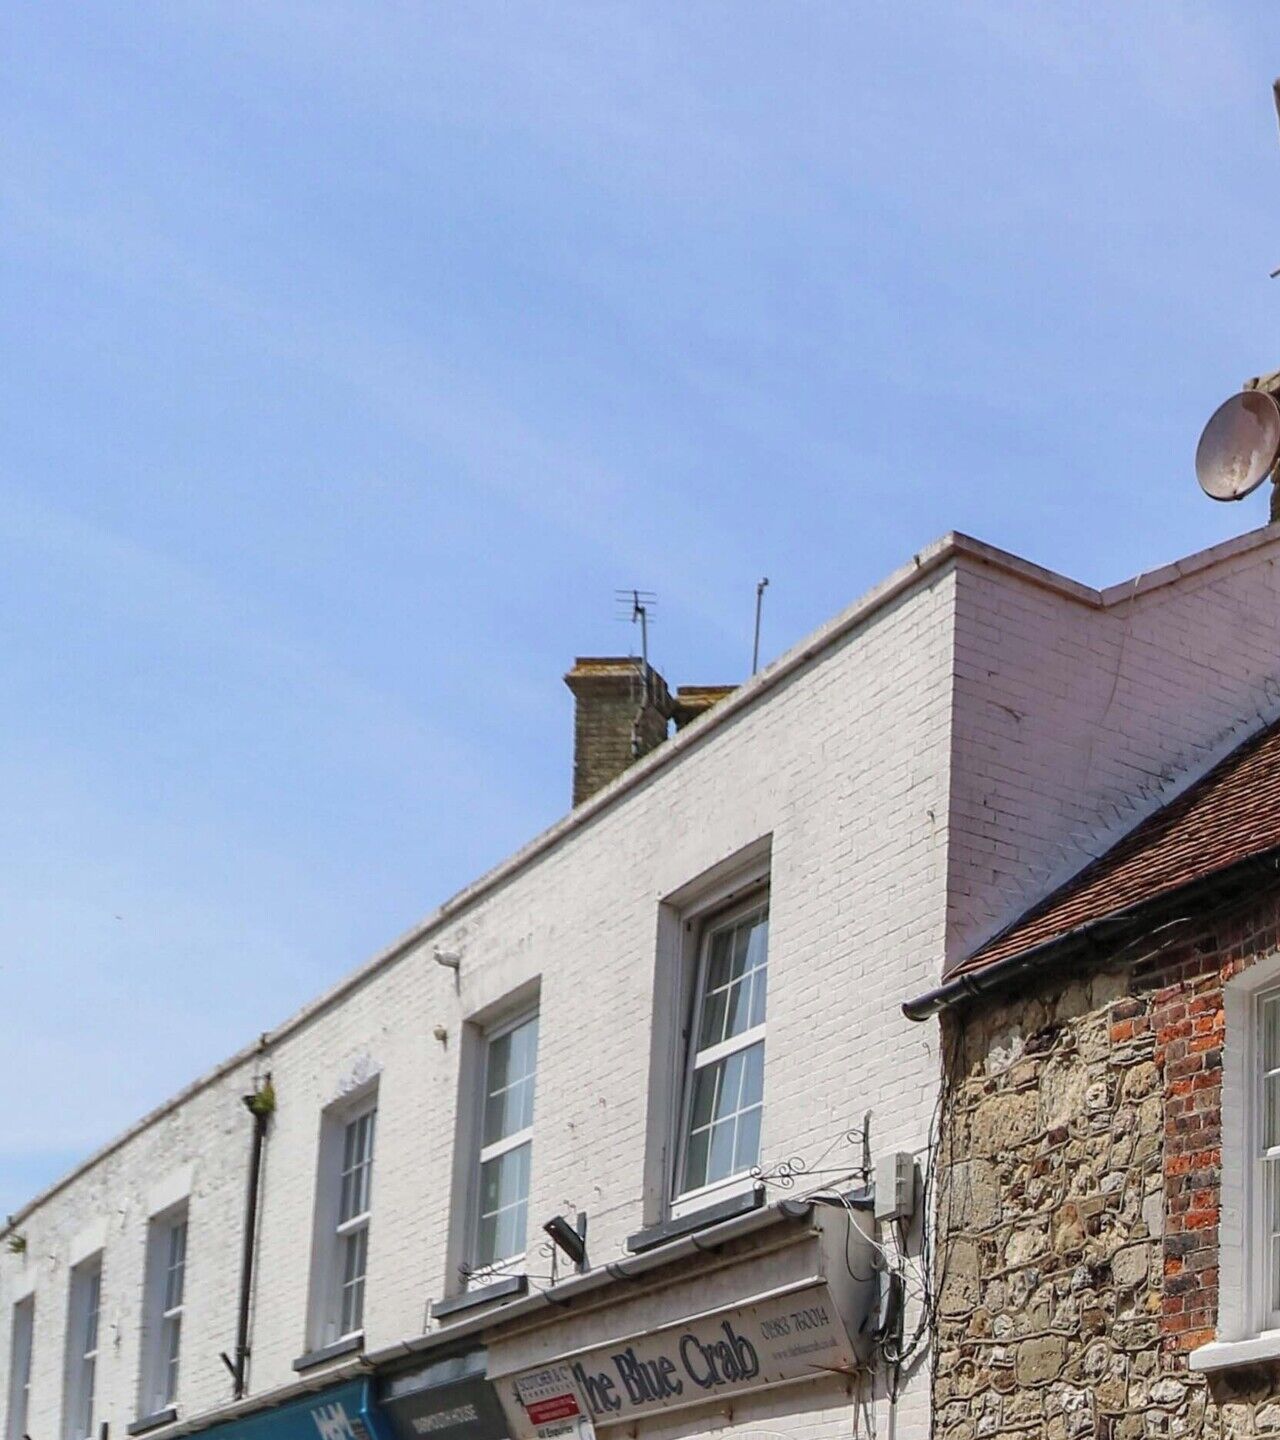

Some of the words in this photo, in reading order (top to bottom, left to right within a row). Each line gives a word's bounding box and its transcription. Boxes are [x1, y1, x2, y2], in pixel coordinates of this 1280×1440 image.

[571, 1362, 621, 1415] he
[611, 1347, 683, 1406] Blue
[679, 1320, 760, 1389] Crab
